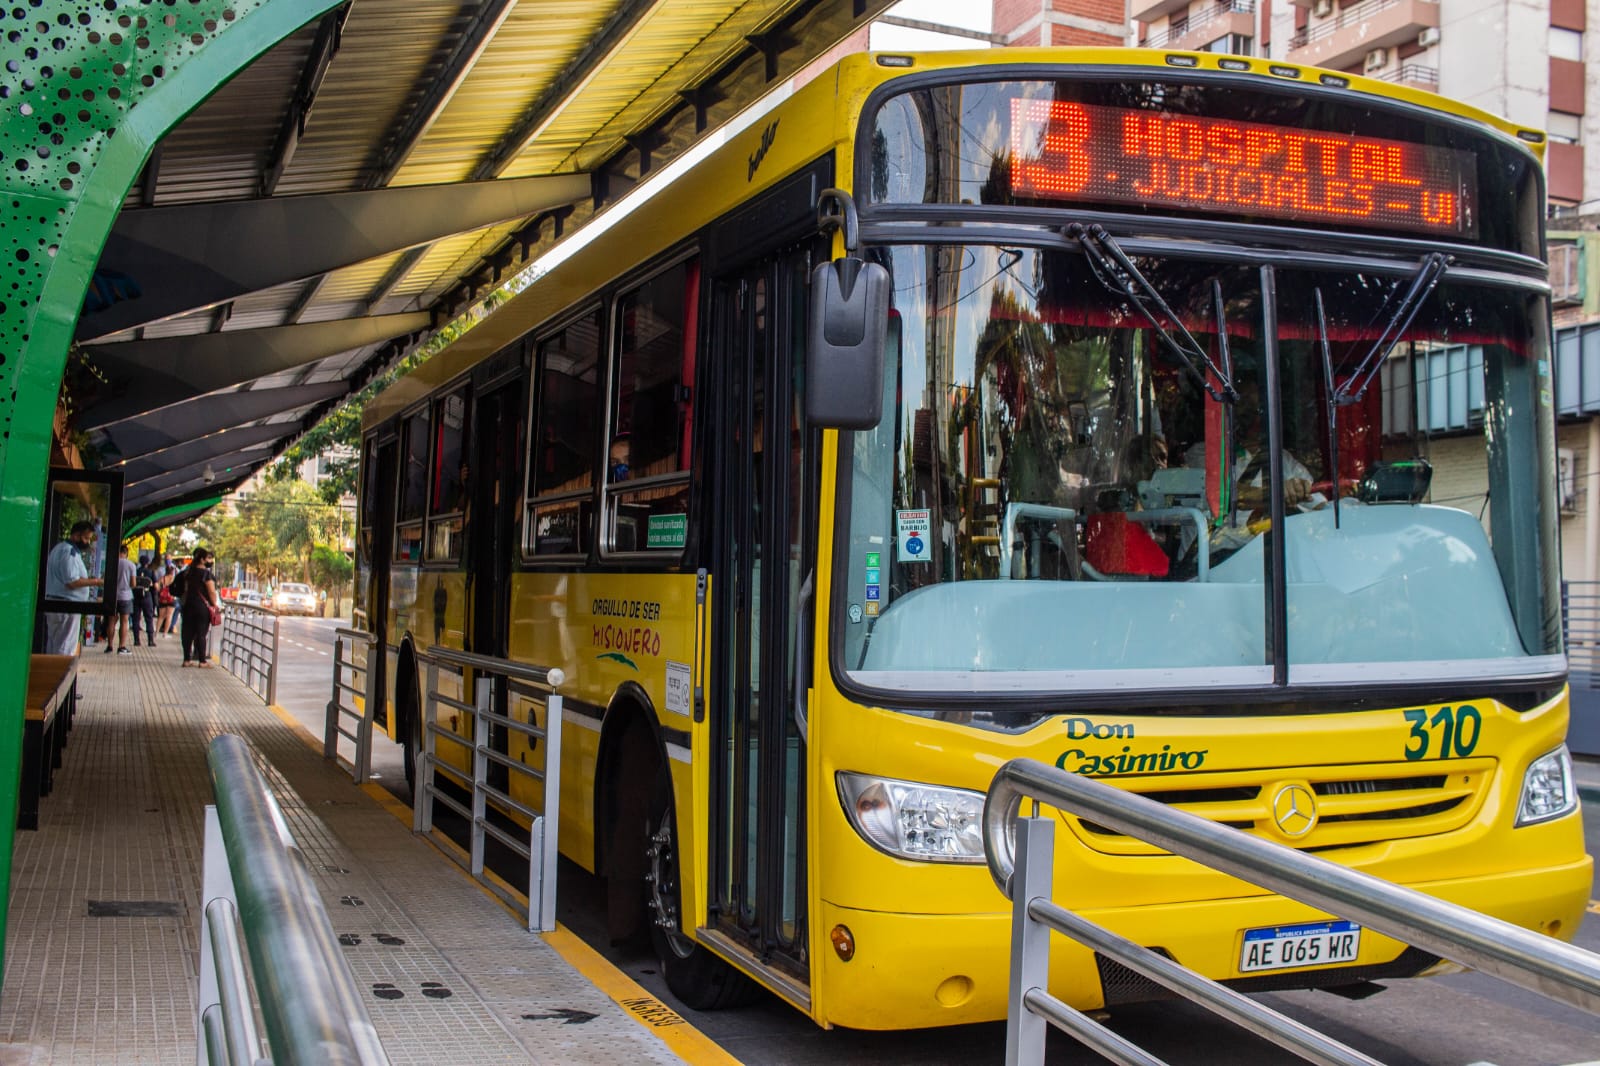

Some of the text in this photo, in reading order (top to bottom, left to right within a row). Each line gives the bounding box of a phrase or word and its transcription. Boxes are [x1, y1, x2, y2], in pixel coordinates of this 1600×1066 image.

[1124, 112, 1422, 186] HOSPITAL
[1132, 161, 1374, 216] JUDICIALES
[592, 598, 661, 621] ORGULLO DE SER
[592, 623, 661, 656] MISIONERO
[1062, 717, 1135, 740] Don
[1402, 704, 1482, 762] 310
[1055, 744, 1209, 775] Casimiro
[1303, 927, 1330, 935] ARGENTINA
[1247, 934, 1354, 967] AE 065 WR
[620, 997, 686, 1027] INGRESO
